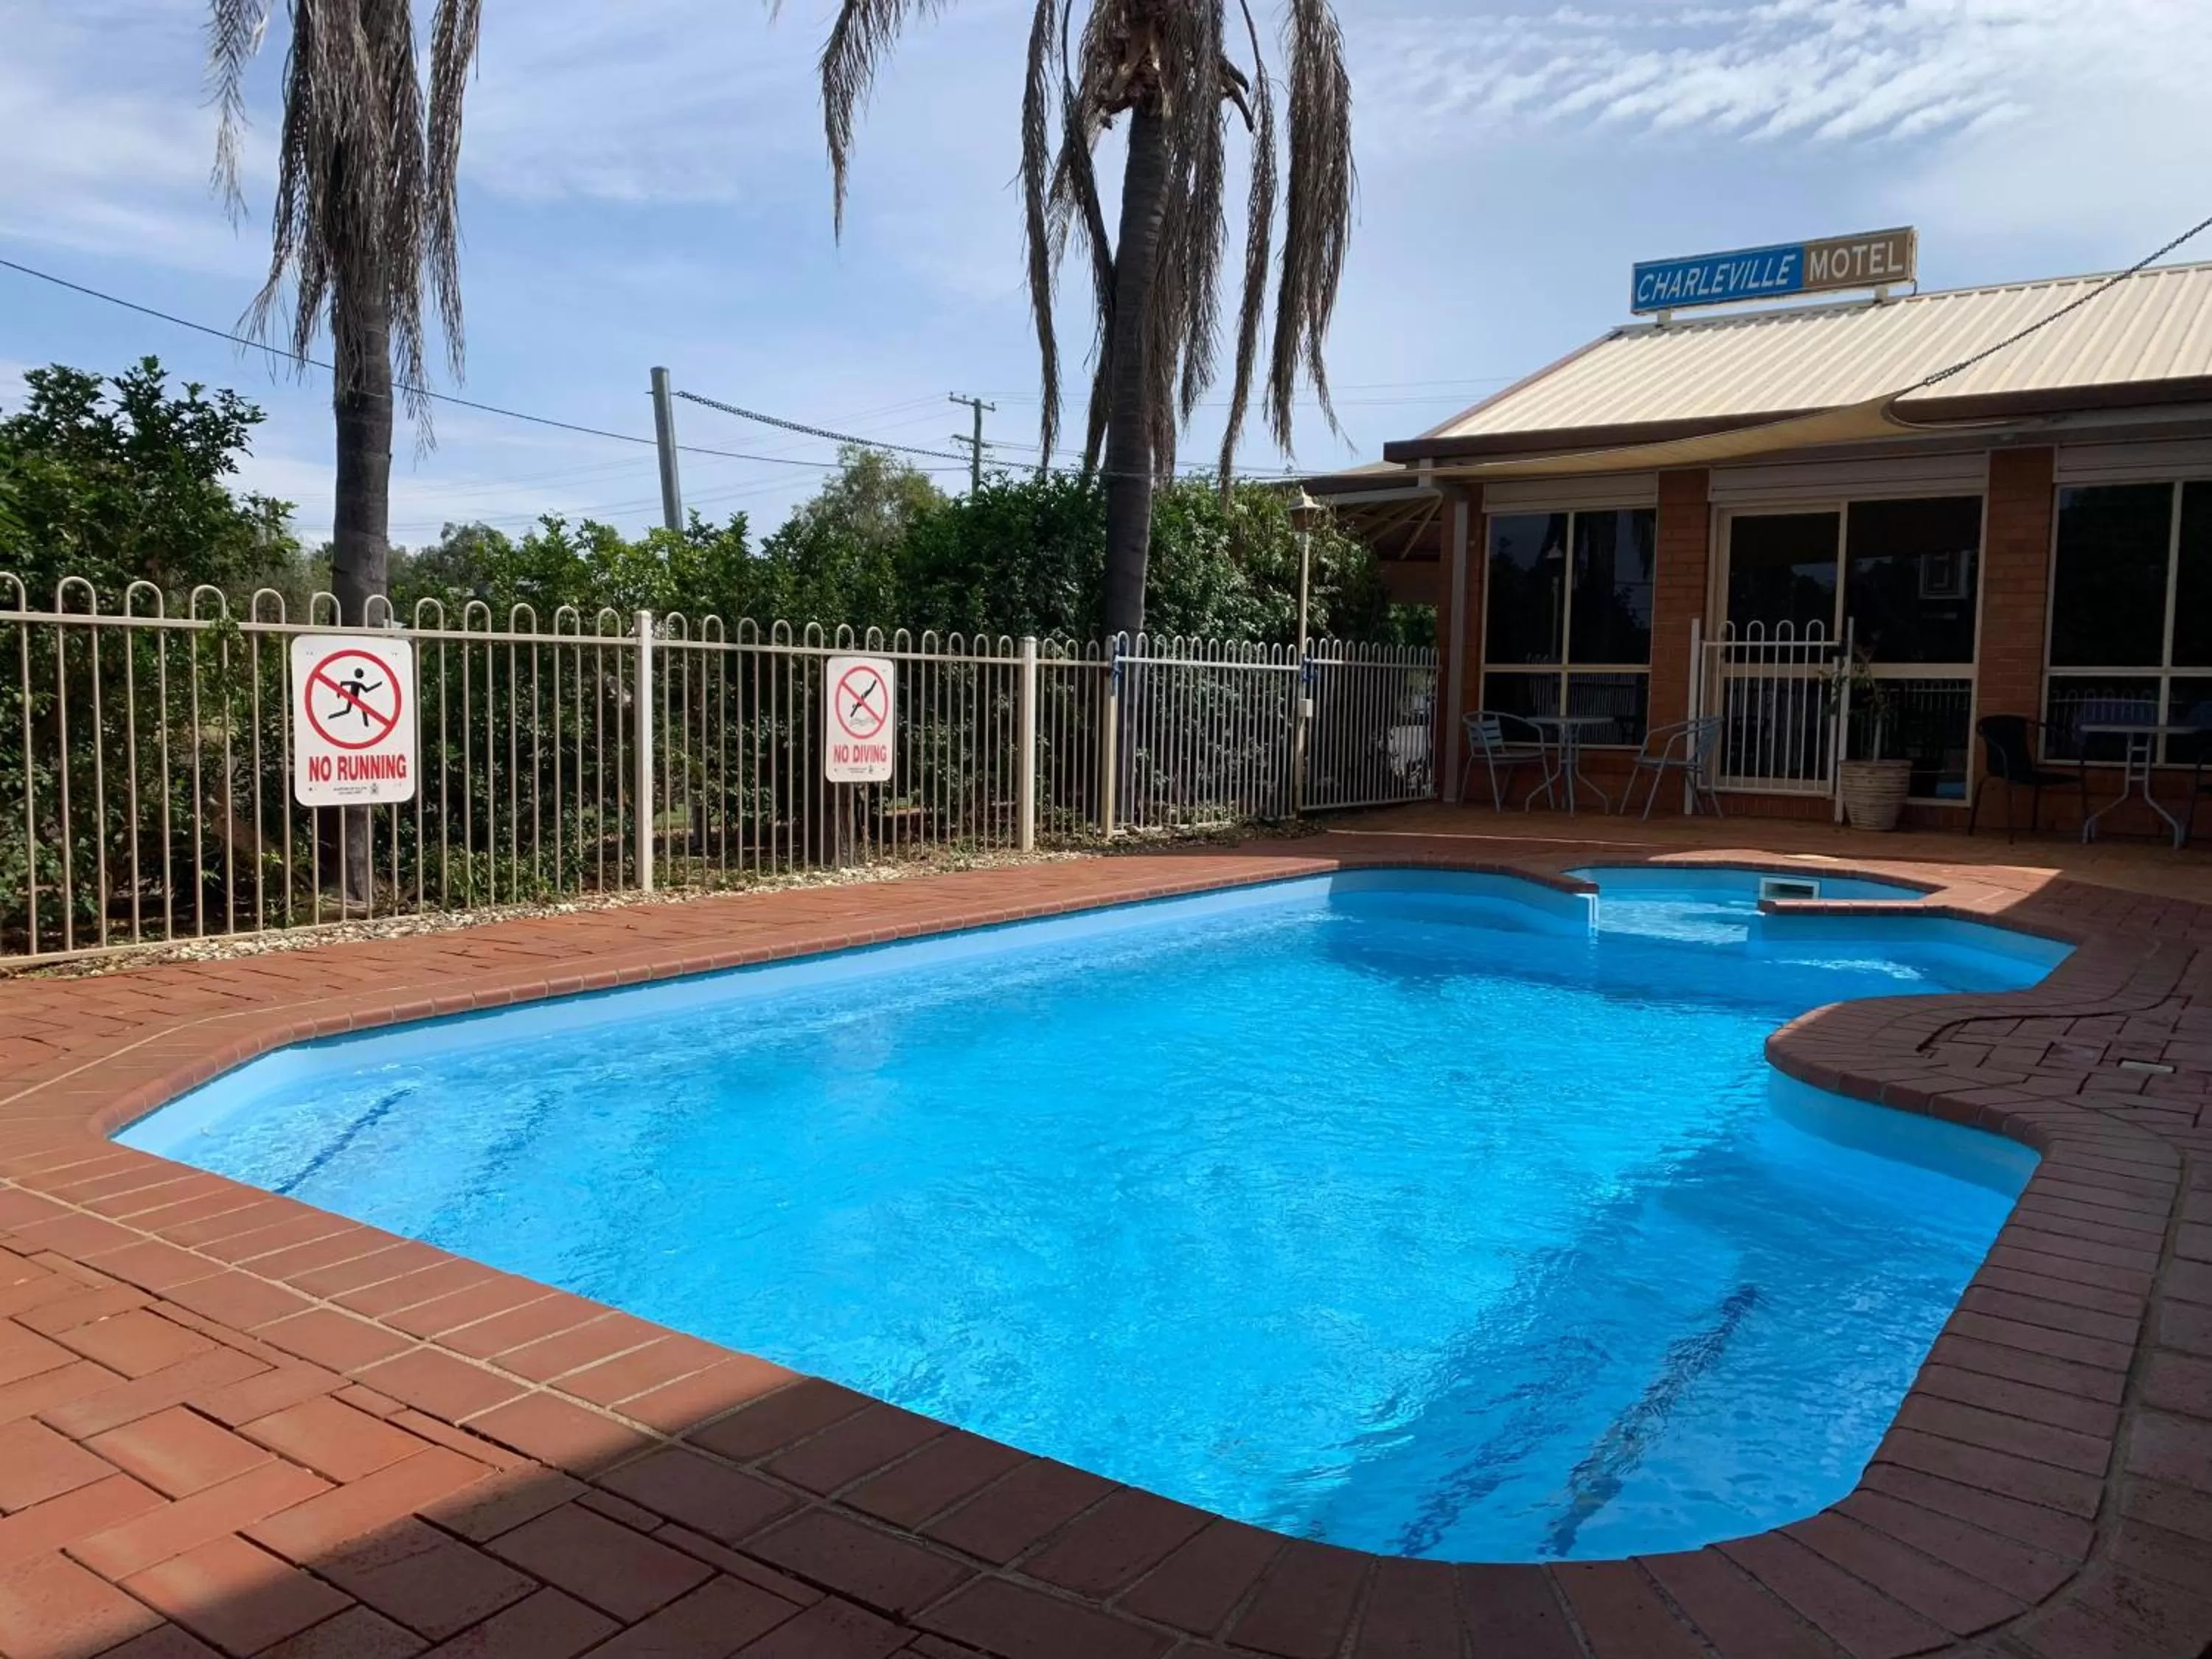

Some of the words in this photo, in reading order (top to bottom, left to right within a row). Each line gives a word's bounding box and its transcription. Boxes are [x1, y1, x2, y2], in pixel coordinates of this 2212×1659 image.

[1638, 254, 1797, 302] CHARLEVILLE
[1809, 240, 1904, 282] MOTEL
[833, 744, 849, 763] NO
[852, 744, 887, 763] DIVING
[308, 755, 332, 782] NO
[337, 754, 408, 781] RUNNING
